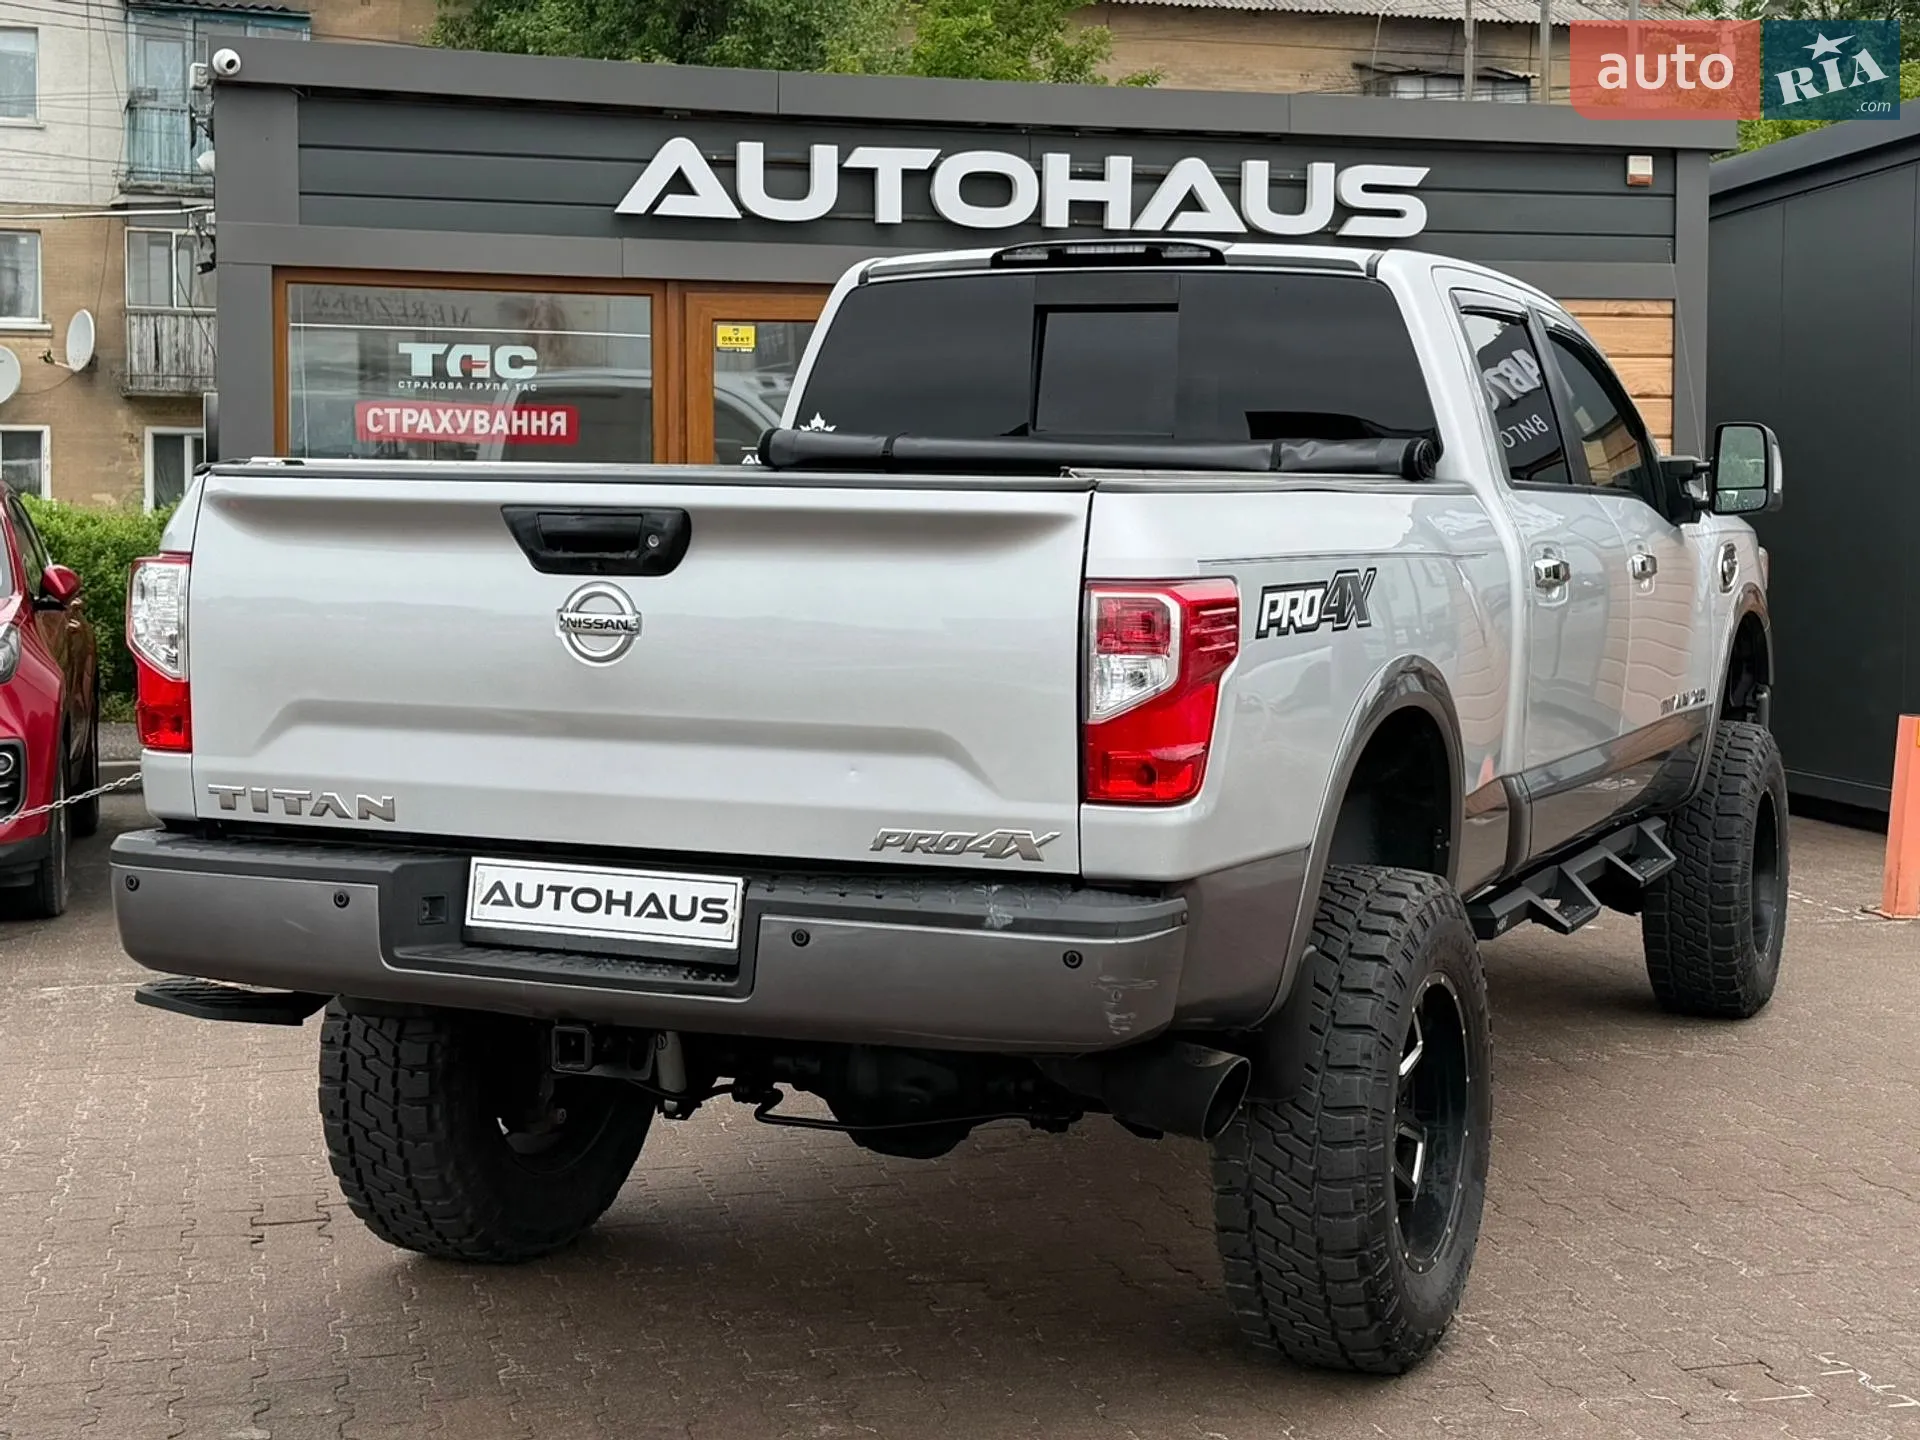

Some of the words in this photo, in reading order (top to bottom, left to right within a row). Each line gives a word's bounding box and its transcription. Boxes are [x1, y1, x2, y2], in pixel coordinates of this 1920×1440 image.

[614, 137, 1432, 238] AUTOHAUS
[398, 381, 463, 391] СТРАХОВА
[469, 382, 510, 392] ГРУПА
[515, 383, 538, 392] ТАС
[366, 407, 567, 437] СТРАХУВАННЯ
[1255, 567, 1377, 640] PRO4X
[566, 616, 629, 631] NISSAN
[208, 783, 396, 822] TITAN
[869, 828, 1061, 862] PRO4X
[480, 880, 729, 925] AUTOHAUS
